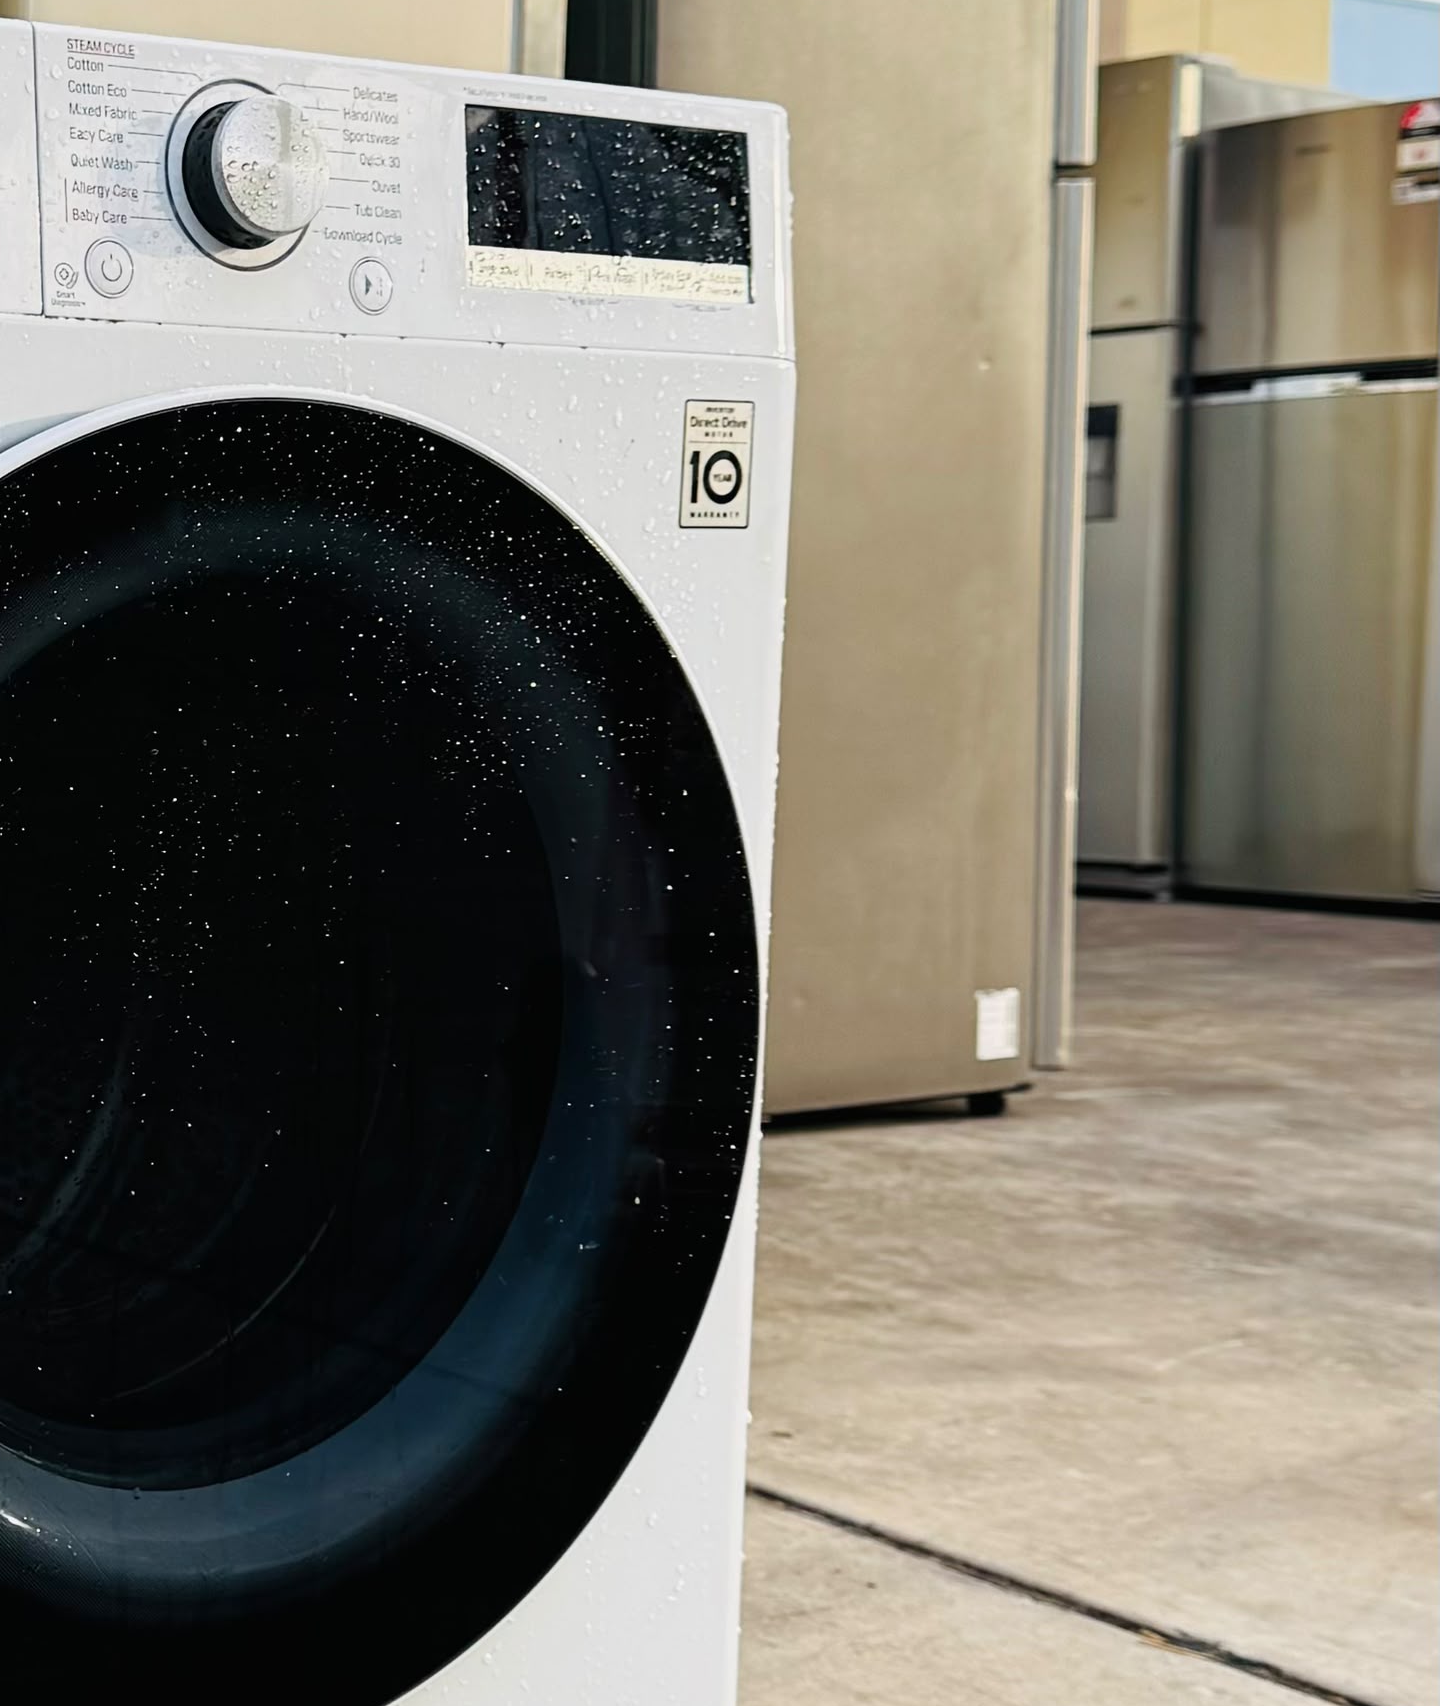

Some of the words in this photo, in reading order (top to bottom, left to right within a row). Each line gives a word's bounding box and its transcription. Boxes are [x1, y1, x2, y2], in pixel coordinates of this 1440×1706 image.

[66, 37, 101, 52] STEAM
[103, 41, 135, 56] CYCLE
[67, 56, 104, 72] Cotton
[67, 79, 104, 96] Cotton
[106, 83, 127, 98] Eco
[68, 102, 101, 118] Mixed
[104, 105, 138, 121] Fabric
[69, 126, 96, 144] Easy
[98, 129, 124, 144] Care
[70, 153, 100, 169] Quiet
[101, 156, 133, 172] Wash
[71, 180, 110, 199] Allergy
[112, 183, 138, 199] Care
[72, 207, 100, 225] Baby
[101, 210, 128, 225] Care
[689, 415, 720, 428] Direct
[721, 416, 748, 429] Drive
[689, 449, 743, 505] 10
